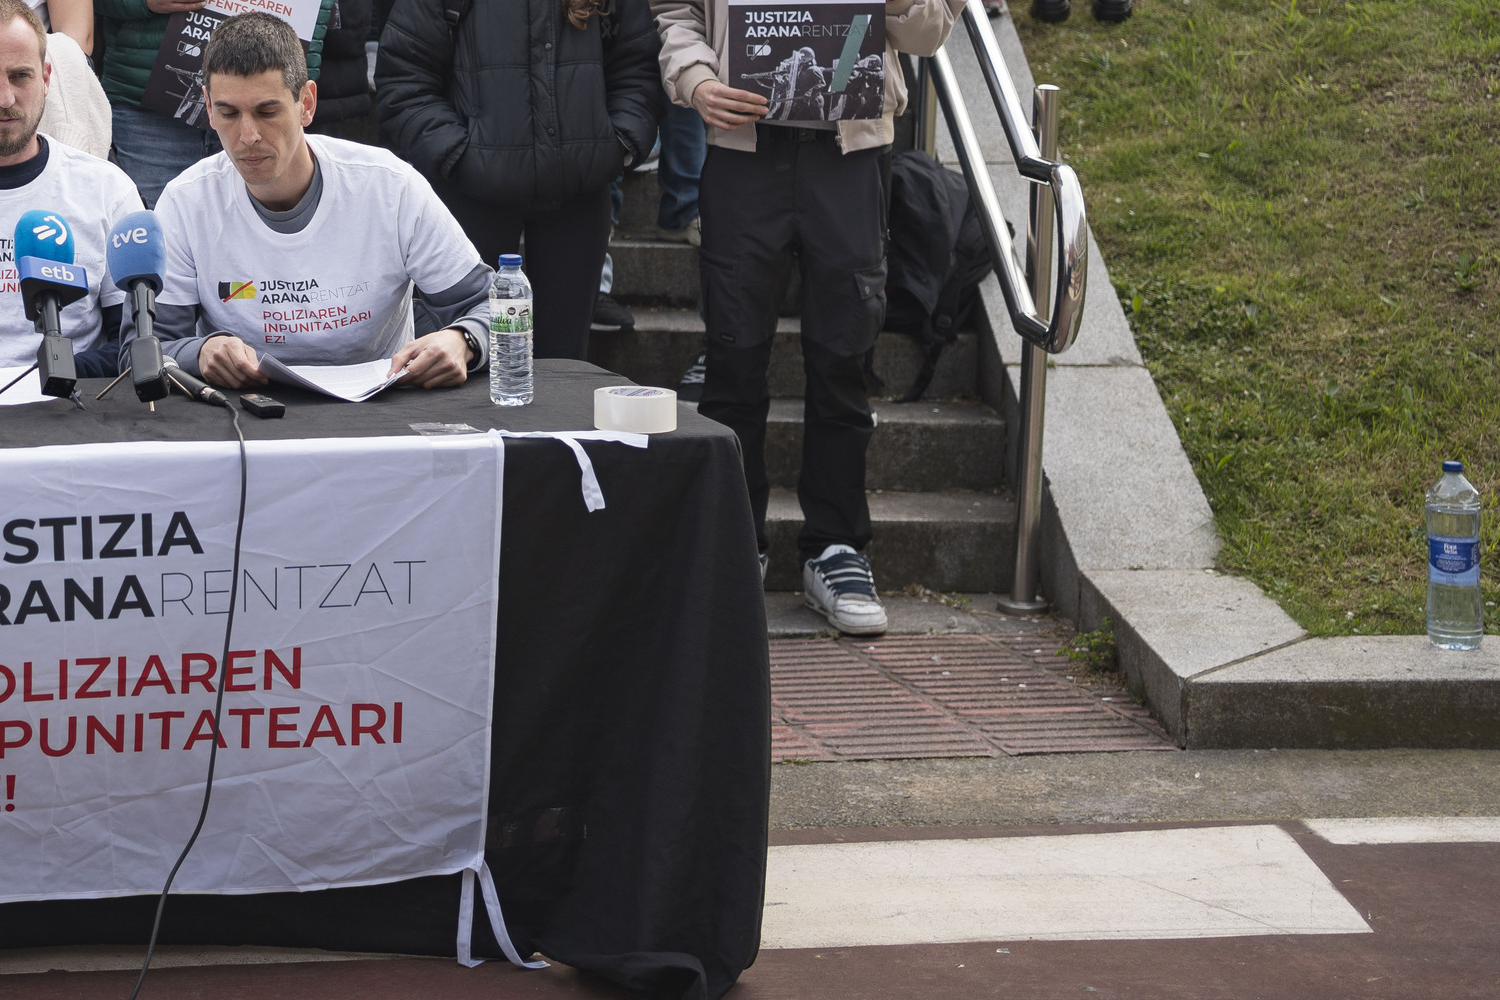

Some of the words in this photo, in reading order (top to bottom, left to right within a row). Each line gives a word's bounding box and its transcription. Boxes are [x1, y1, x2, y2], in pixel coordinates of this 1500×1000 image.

[186, 11, 221, 30] JUST
[745, 11, 813, 23] JUSTIZIA
[111, 226, 149, 250] tve
[40, 265, 75, 283] etb
[260, 278, 319, 292] JUSTIZIA
[261, 281, 370, 305] ARANARENTZAT
[263, 305, 348, 321] POLIZIAREN
[264, 310, 372, 333] INPUNITATEARI
[265, 335, 286, 344] EZ!
